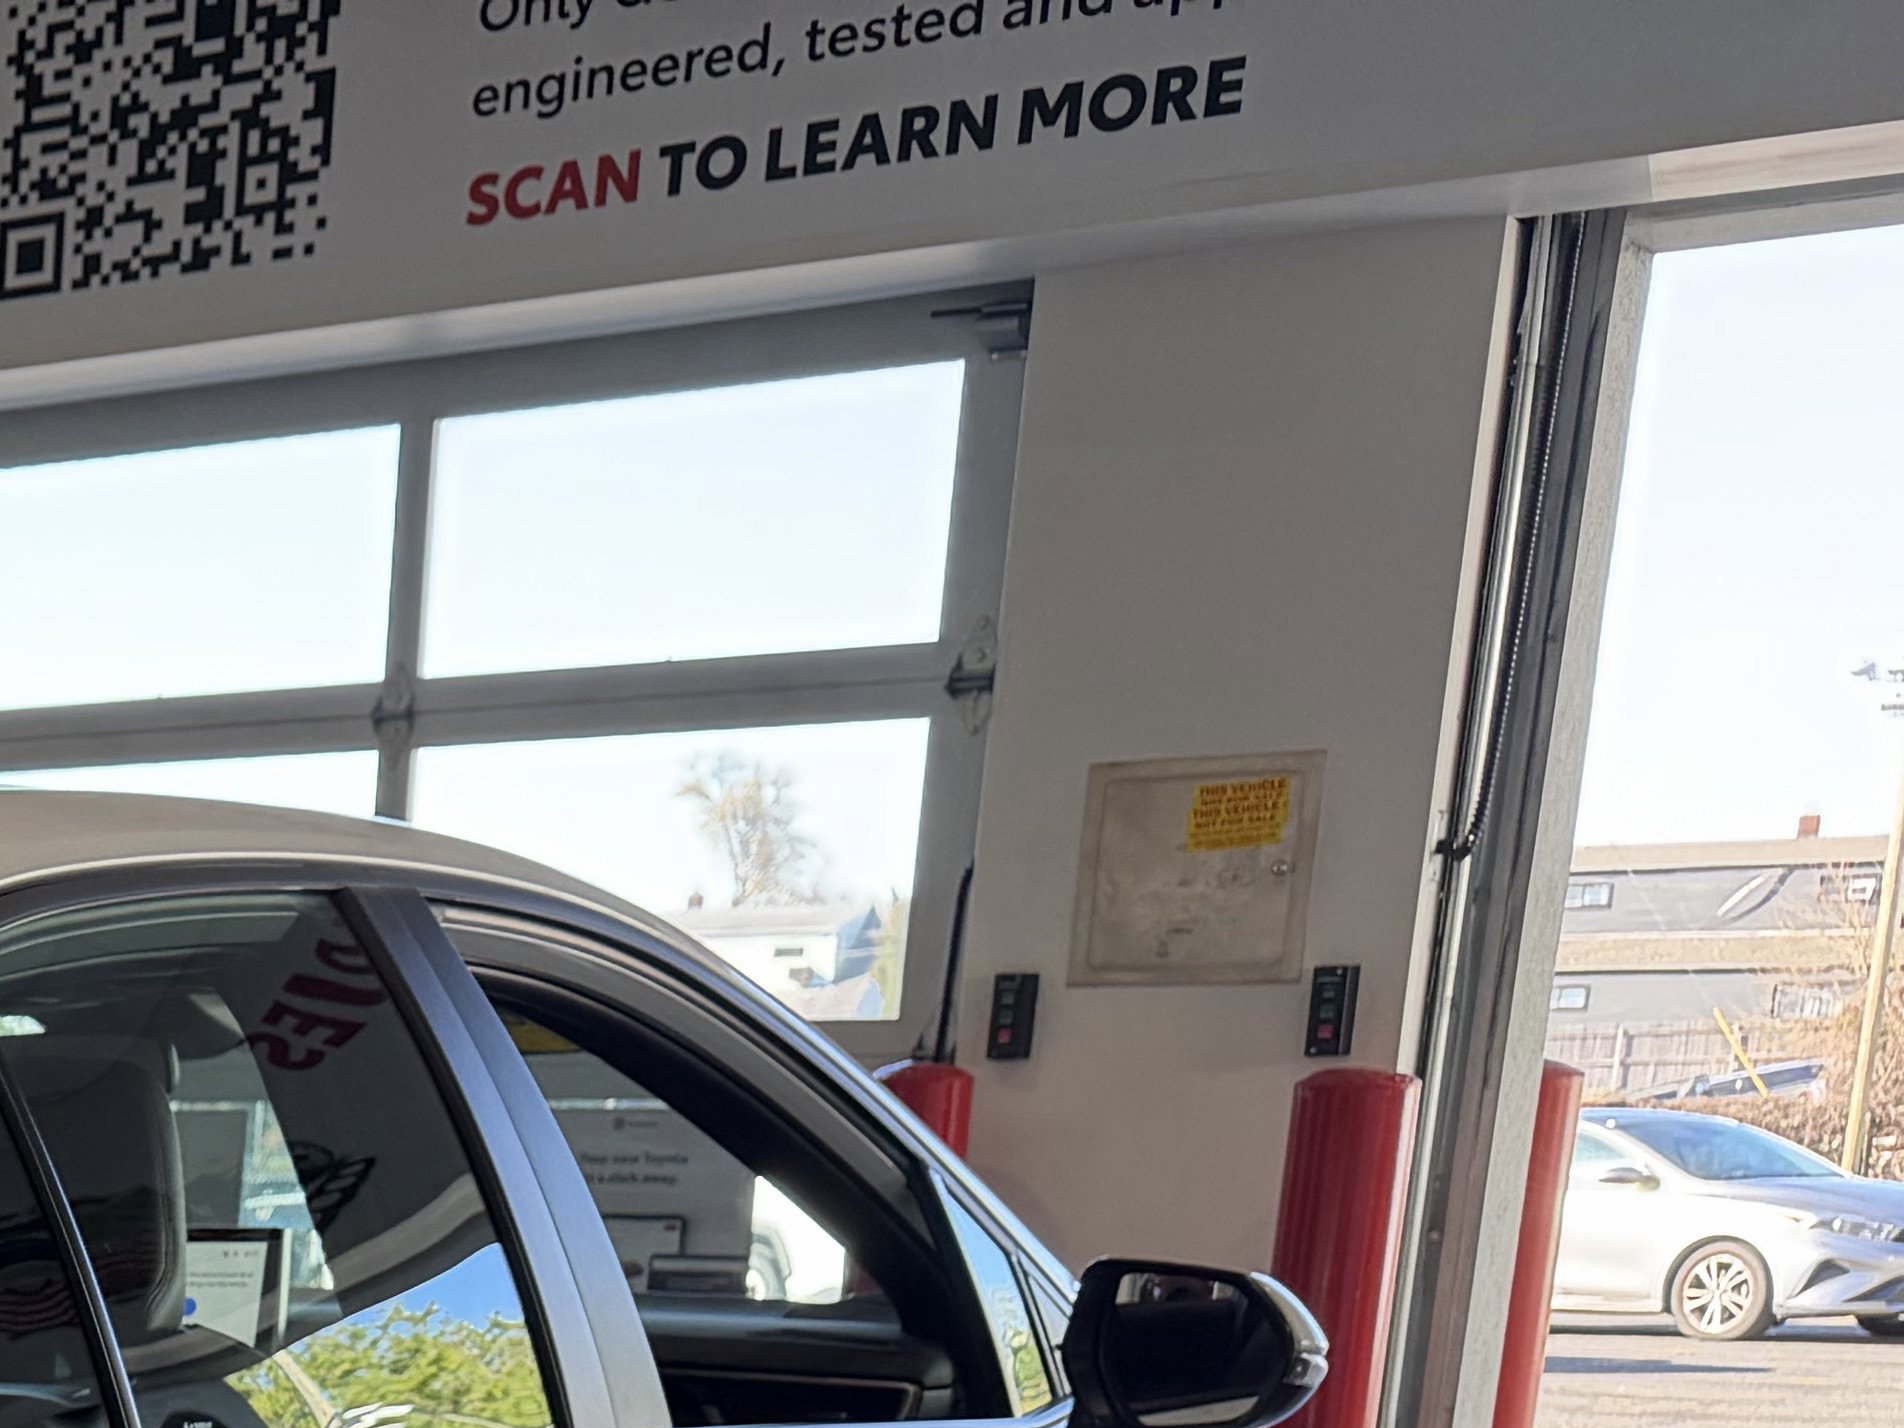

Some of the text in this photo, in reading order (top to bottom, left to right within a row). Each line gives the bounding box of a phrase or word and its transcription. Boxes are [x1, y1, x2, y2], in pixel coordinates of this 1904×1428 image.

[472, 22, 786, 119] engineered,
[805, 0, 984, 62] tested
[465, 54, 1247, 227] SCAN TO LEARN MORE
